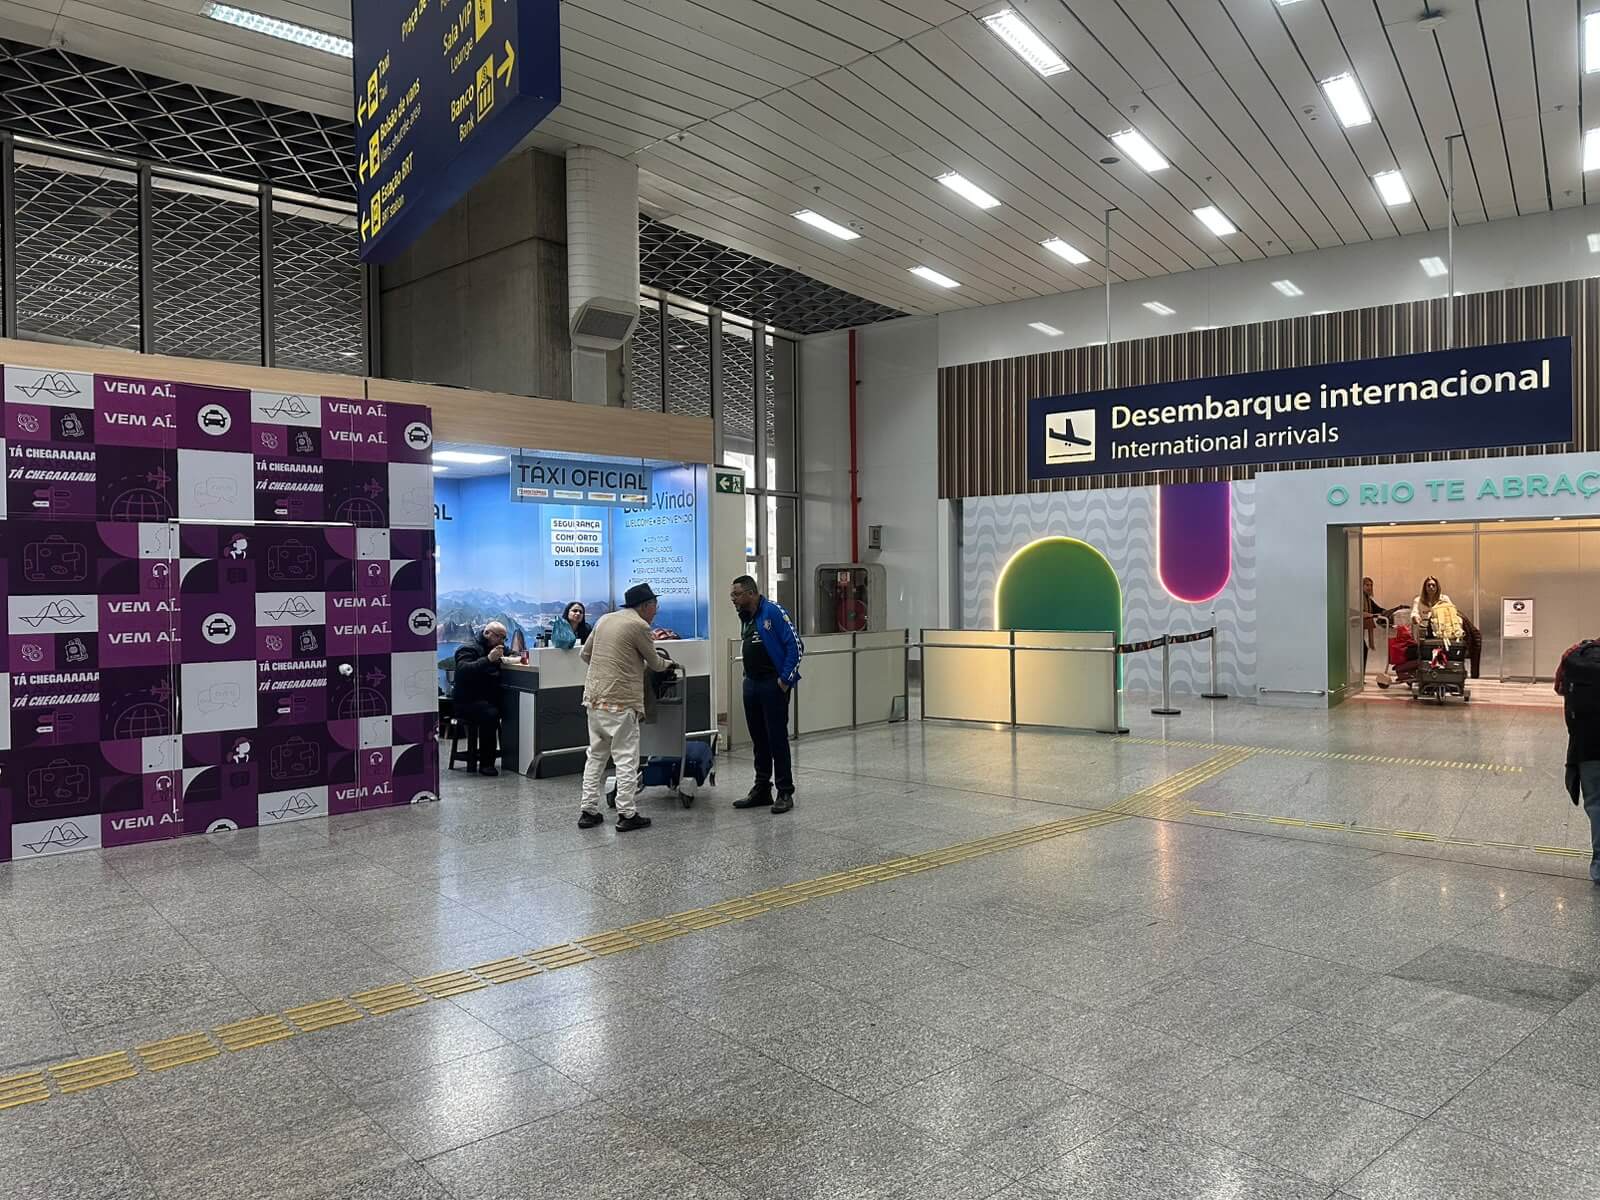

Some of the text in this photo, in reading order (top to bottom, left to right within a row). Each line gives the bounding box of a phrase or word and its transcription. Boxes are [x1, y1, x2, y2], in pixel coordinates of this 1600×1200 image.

[402, 7, 418, 42] Praça
[443, 24, 458, 56] Sala
[459, 0, 472, 32] VIP
[451, 37, 473, 73] Lounge
[451, 84, 474, 122] Banco
[380, 106, 399, 141] Bolsão
[459, 112, 474, 142] Bank
[381, 151, 413, 203] Estação BRT
[103, 381, 146, 395] VEM
[1112, 359, 1550, 429] Desembarque internacional
[329, 402, 362, 415] VEM
[103, 412, 147, 426] VEM
[329, 430, 363, 442] VEM
[1112, 422, 1338, 459] International arrivals
[8, 445, 23, 457] TÁ
[255, 459, 267, 471] TÁ
[8, 466, 25, 479] TÁ
[517, 461, 648, 490] TÁXI OFICIAL
[255, 478, 269, 490] TÁ
[1327, 470, 1600, 506] O RIO TE ABRAÇ
[553, 520, 600, 529] SEGURANÇA
[555, 546, 599, 554] QUALIDADE
[554, 559, 600, 567] DESDE 1961
[107, 601, 151, 612] VEM
[333, 598, 367, 607] VEM
[333, 625, 367, 635] VEM
[108, 632, 151, 644] VEM
[259, 660, 270, 671] TÁ
[12, 673, 27, 686] TÁ
[258, 679, 271, 691] TÁ
[12, 694, 29, 707] TÁ
[336, 787, 368, 800] VEM
[111, 815, 154, 830] VEM
